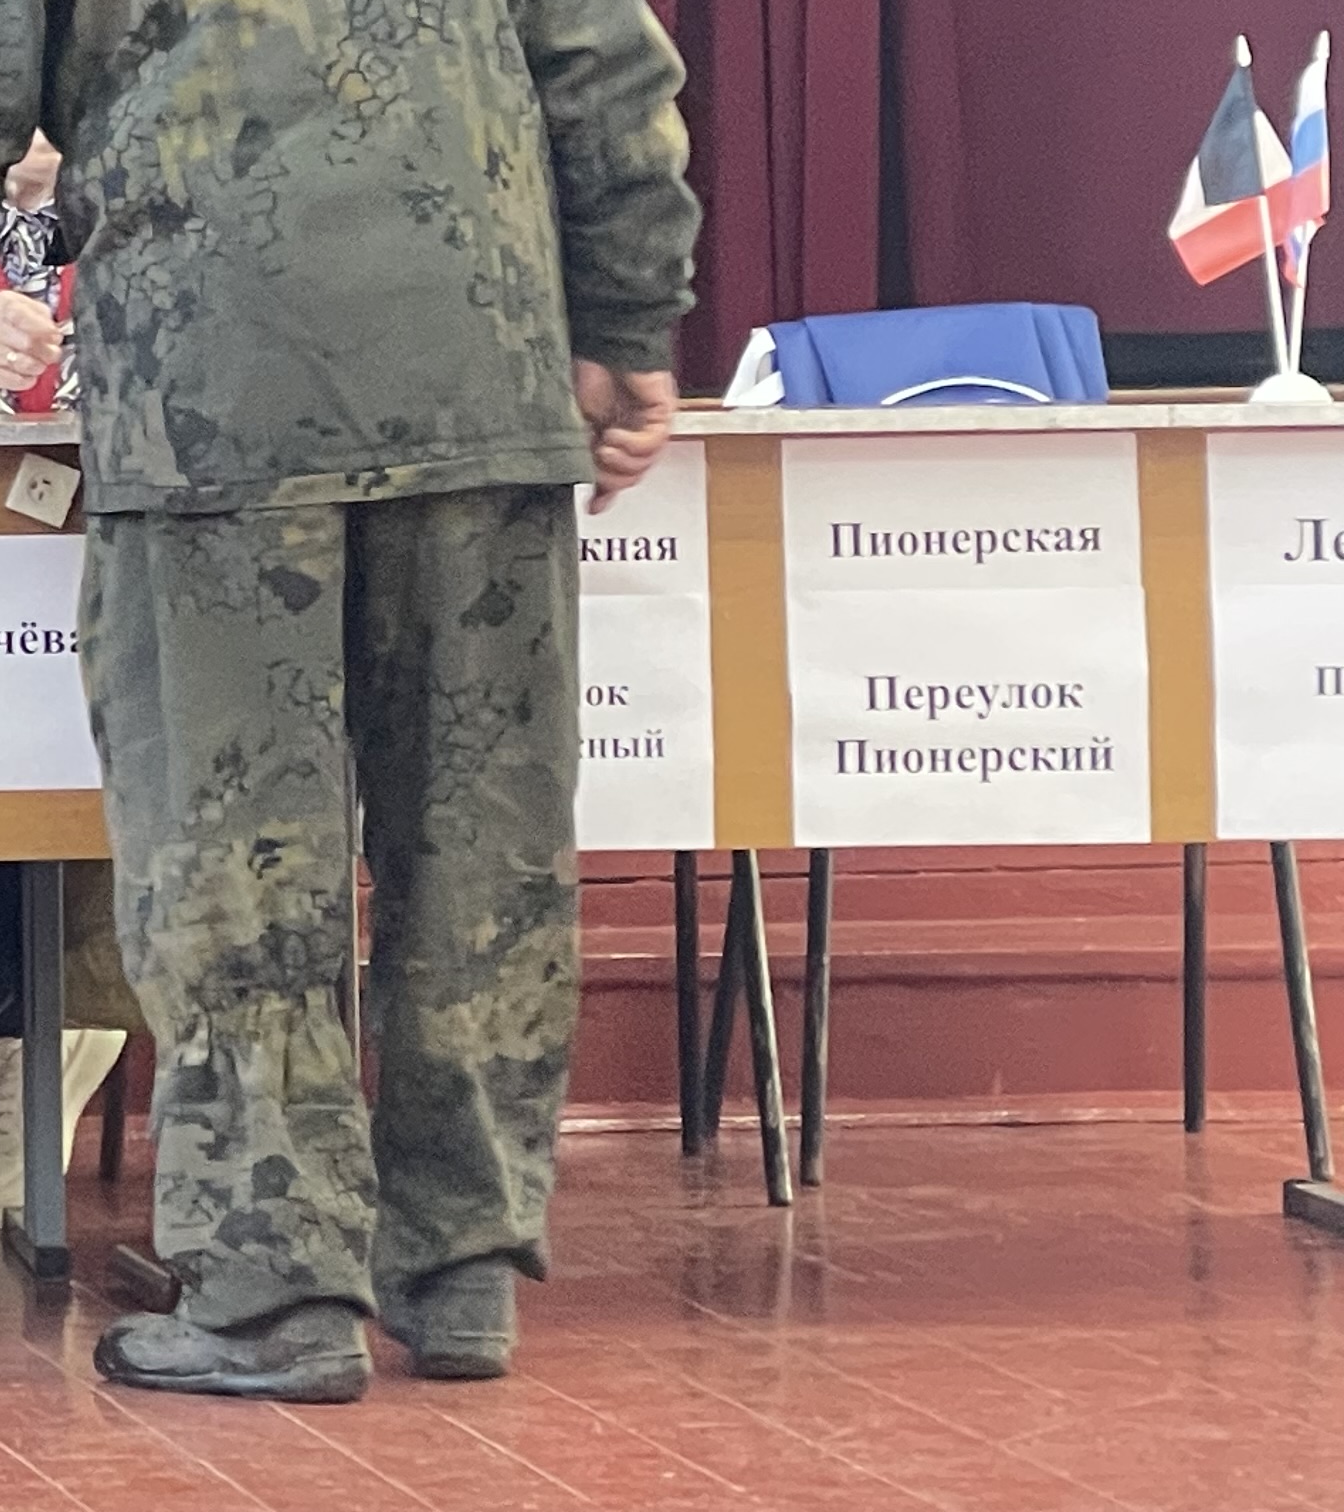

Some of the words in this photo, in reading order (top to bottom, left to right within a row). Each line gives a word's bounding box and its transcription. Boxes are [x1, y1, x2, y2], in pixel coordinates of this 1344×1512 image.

[830, 522, 1101, 565] Пионерская
[864, 675, 1084, 720] Переулок
[835, 736, 1114, 783] Пионерский
